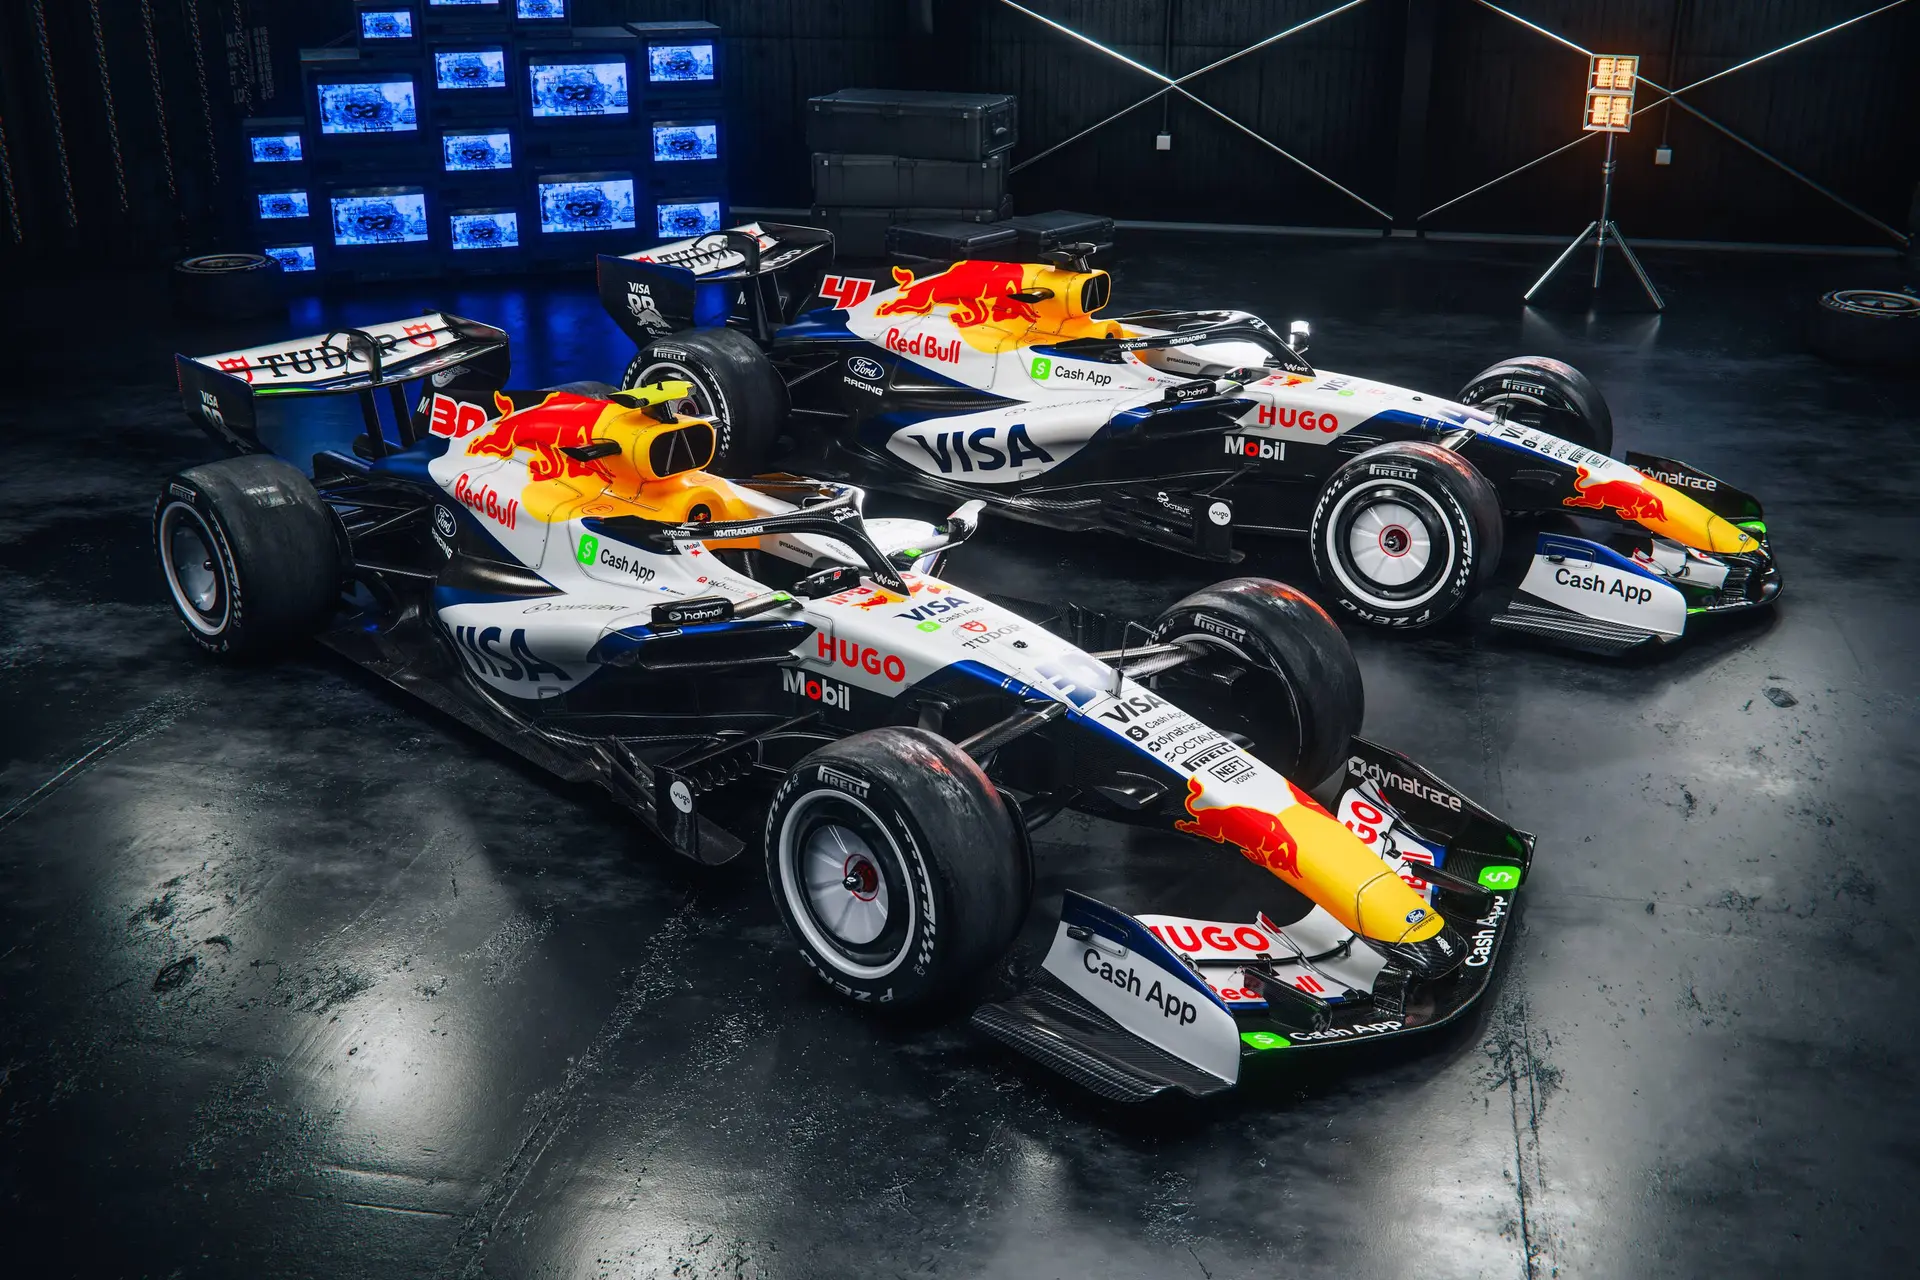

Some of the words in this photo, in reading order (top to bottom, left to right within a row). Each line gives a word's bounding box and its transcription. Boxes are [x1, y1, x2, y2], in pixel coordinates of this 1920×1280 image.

[627, 281, 651, 295] VISA
[653, 348, 687, 362] PIRELLI
[885, 327, 922, 357] Red
[923, 332, 962, 364] Bull
[844, 376, 884, 396] RACING
[1054, 365, 1085, 382] Cash
[1086, 369, 1112, 386] App
[1501, 379, 1545, 395] PIRELLI
[200, 389, 219, 409] VISA
[1258, 404, 1339, 434] HUGO
[906, 423, 1055, 474] VISA
[1224, 435, 1285, 461] Mobil
[1369, 464, 1418, 480] PIRELLI
[455, 473, 484, 513] Red
[486, 484, 519, 531] Bull
[1163, 501, 1191, 515] OCTAVE
[683, 541, 701, 551] Mobil
[600, 549, 628, 573] Cash
[628, 562, 656, 583] App
[1555, 568, 1605, 595] Cash
[1609, 578, 1652, 604] App
[892, 595, 970, 622] VISA
[938, 609, 963, 624] Cash
[961, 623, 1023, 650] TUDOR
[1194, 613, 1246, 643] PIRELLI
[817, 632, 906, 683] HUGO
[781, 667, 850, 711] Mobil
[1099, 691, 1168, 724] VISA
[1144, 713, 1167, 730] Cash
[1167, 710, 1189, 723] App
[1157, 720, 1203, 747] dynatrace
[1174, 731, 1222, 755] OCTAVE
[1181, 741, 1236, 772] PIRELLI
[1215, 757, 1246, 779] NEFT
[817, 765, 870, 798] PIRELLI
[1232, 770, 1258, 785] VODKA
[1367, 763, 1462, 813] dynatrace
[1477, 895, 1505, 926] App
[1465, 928, 1495, 967] Cash
[1083, 949, 1142, 997] Cash
[1145, 980, 1197, 1027] App
[1290, 1028, 1354, 1041] Cash
[1353, 1020, 1403, 1034] App
